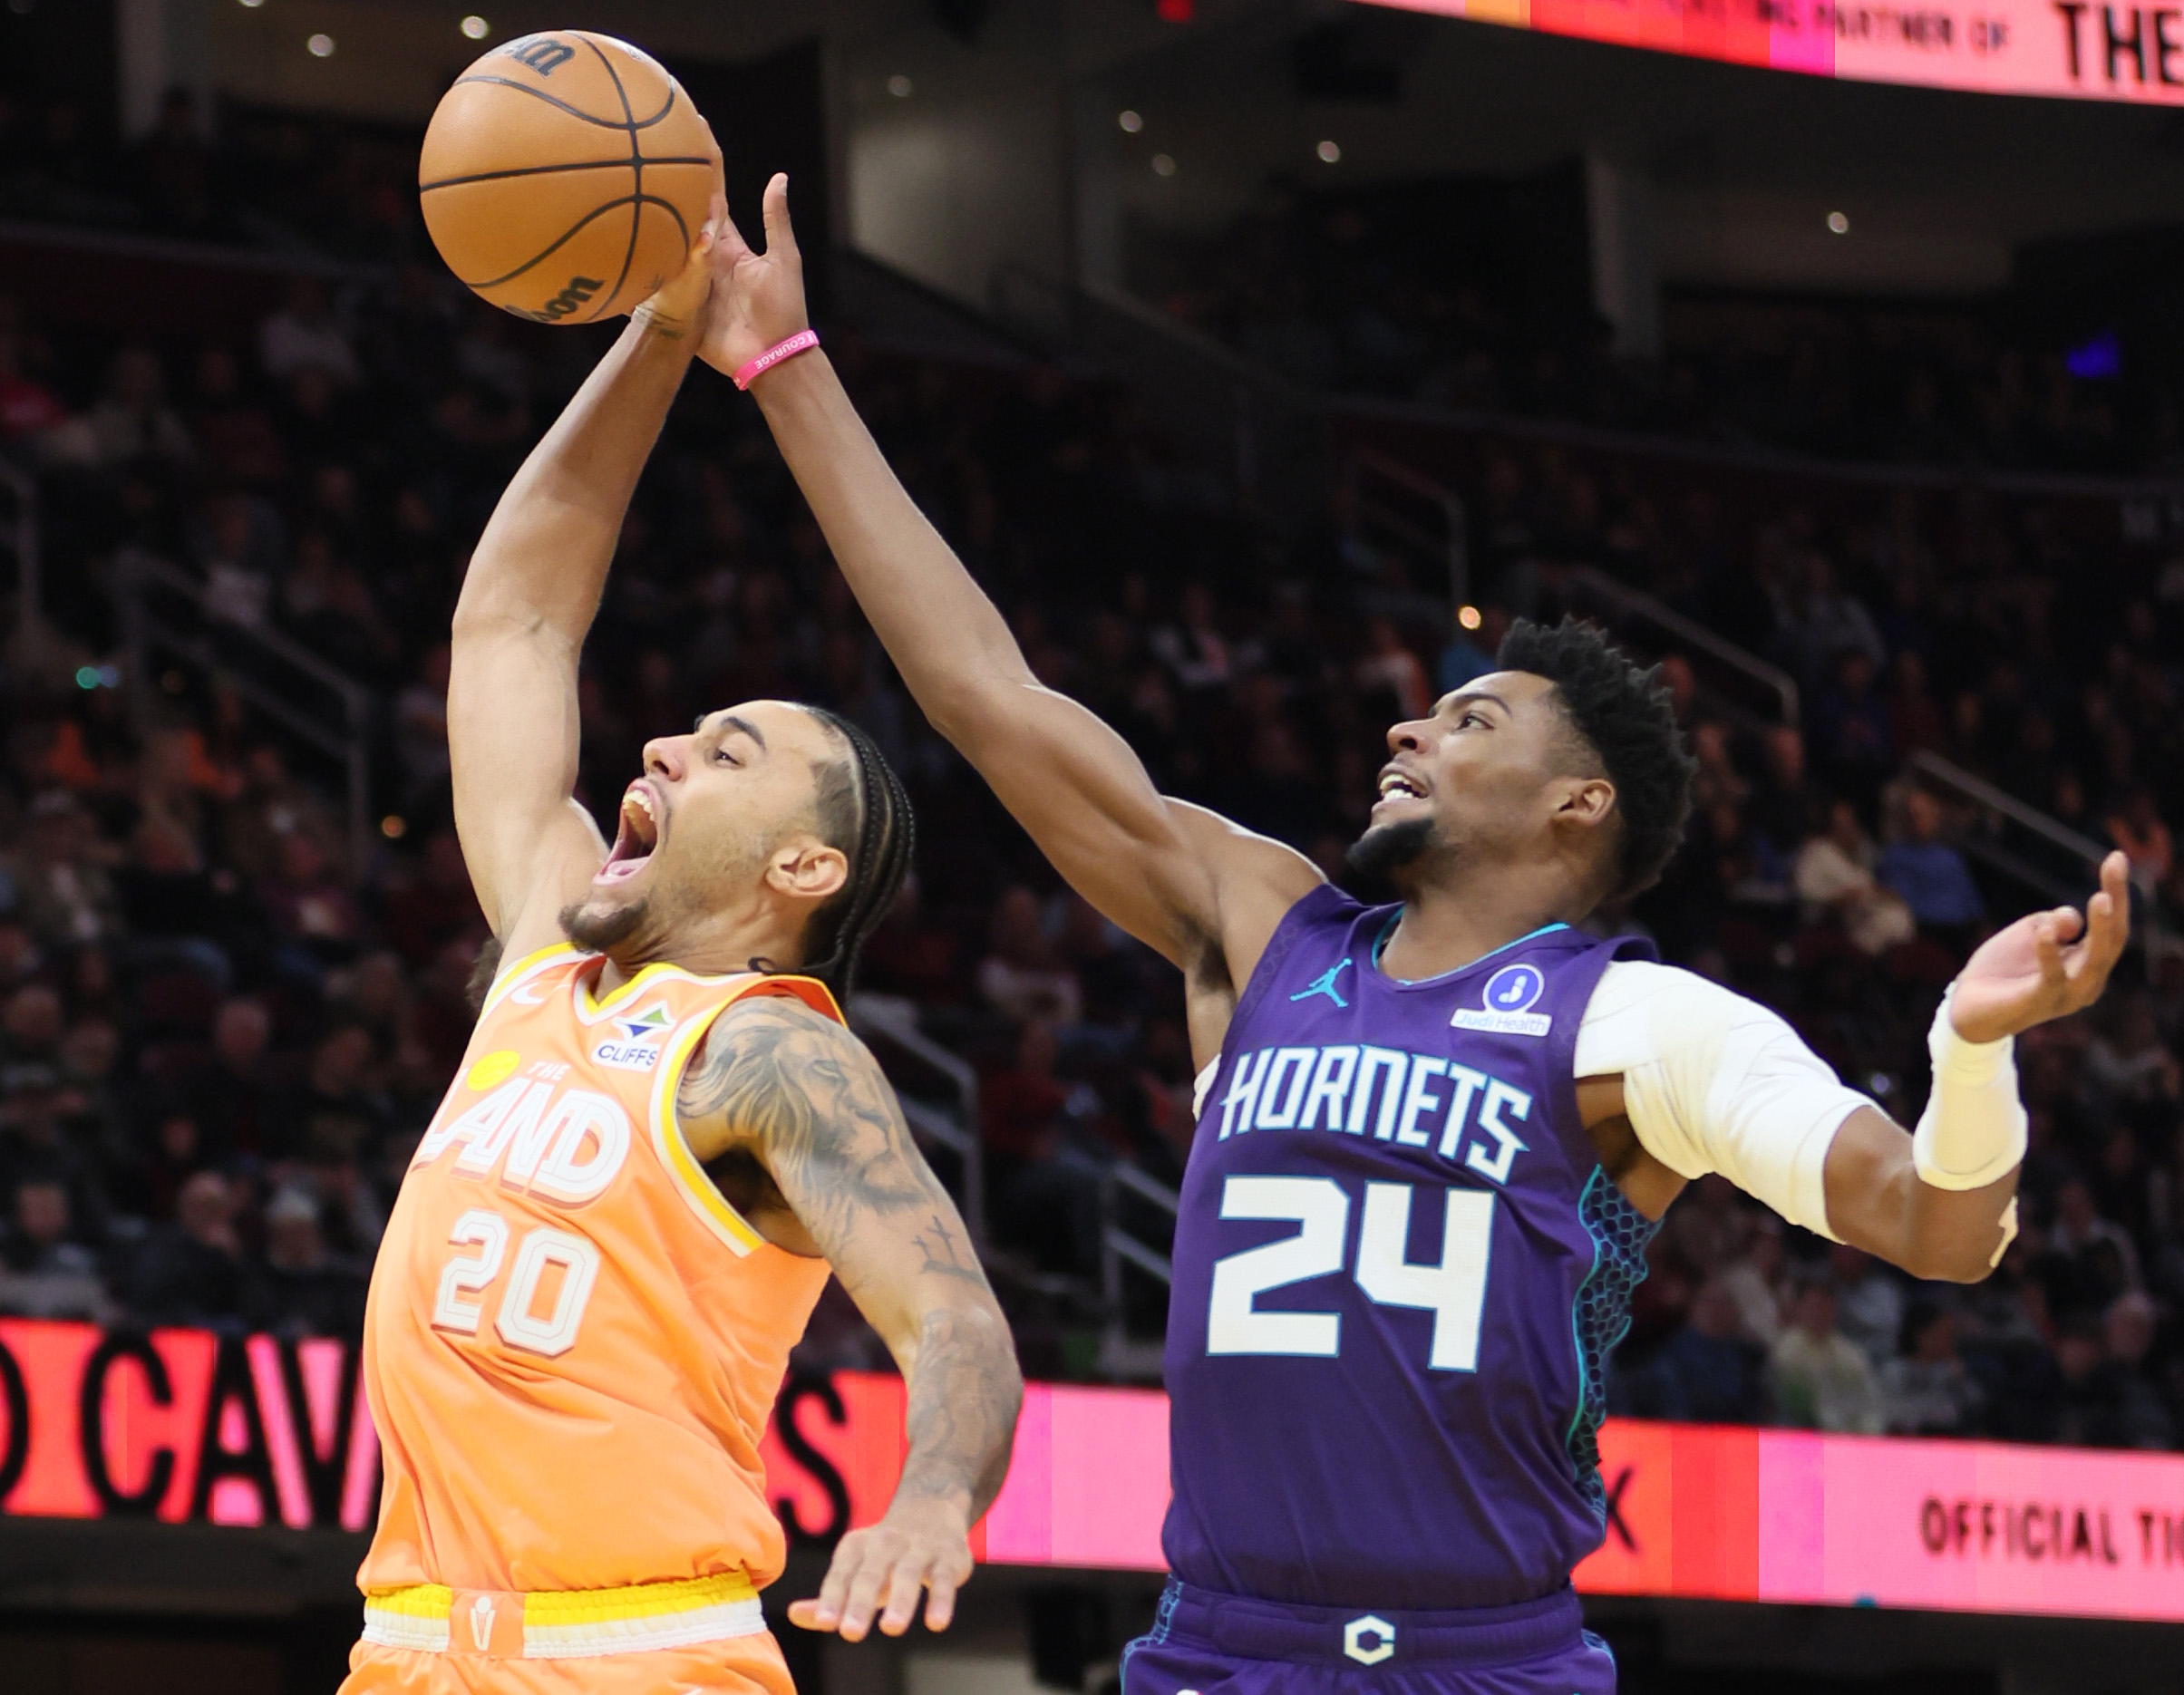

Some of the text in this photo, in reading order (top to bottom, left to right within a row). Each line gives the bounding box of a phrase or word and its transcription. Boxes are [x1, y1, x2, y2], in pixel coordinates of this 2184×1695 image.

[2056, 3, 2184, 87] THE
[753, 336, 806, 370] COURAGE
[597, 1044, 658, 1067] CLIFFS
[1455, 1013, 1546, 1033] Judi Health
[527, 1061, 571, 1081] THE
[1218, 1044, 1533, 1186] HORNETS
[431, 1208, 600, 1358] 20
[1206, 1175, 1497, 1373] 24
[1918, 1497, 2184, 1566] OFFICIAL TI
